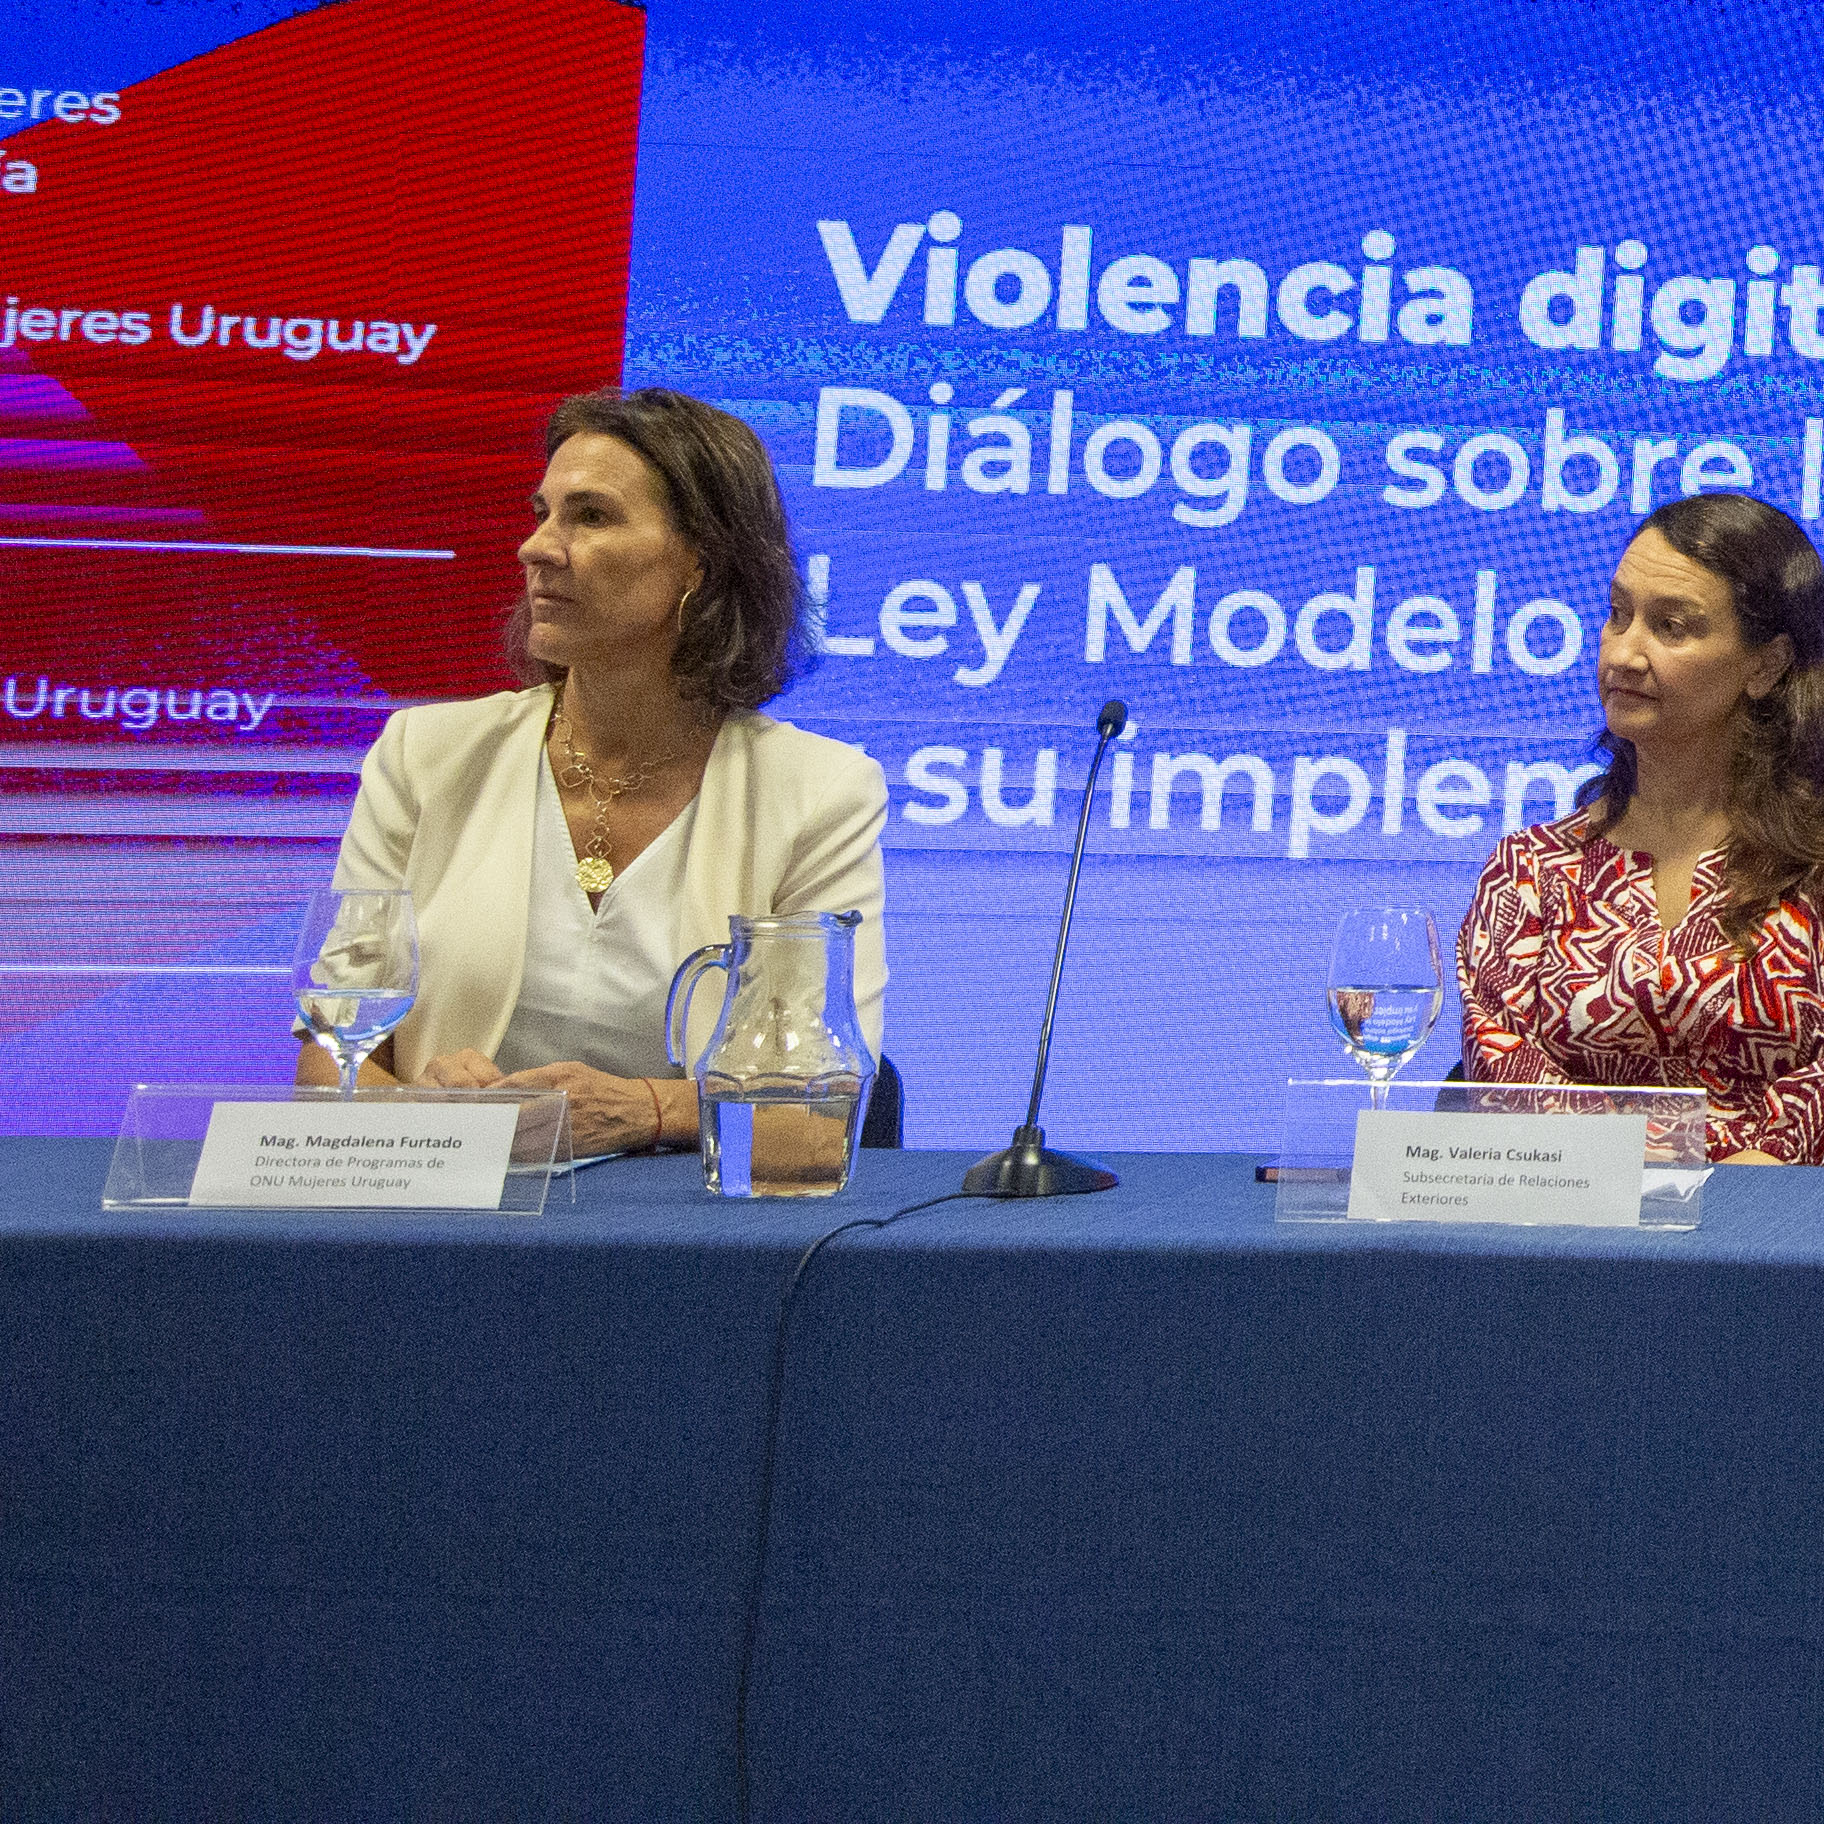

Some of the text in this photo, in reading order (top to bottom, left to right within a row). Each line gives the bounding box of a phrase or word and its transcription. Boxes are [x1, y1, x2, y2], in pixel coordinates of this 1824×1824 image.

[815, 210, 1474, 346] Violencia
[168, 303, 437, 365] Uruguay
[812, 381, 1341, 527] Diálogo
[1382, 407, 1755, 513] sobre
[803, 554, 1041, 688] Ley
[1083, 563, 1584, 677] Modelo
[2, 676, 278, 732] Uruguay
[902, 744, 1057, 827] su
[260, 1134, 463, 1152] Mag. Magdalena Furtado
[1405, 1145, 1562, 1163] Mag. Valeria Csukasi
[254, 1155, 445, 1172] Directora de Programas de
[1499, 1173, 1515, 1187] de
[1519, 1174, 1590, 1189] Relaciones
[249, 1175, 411, 1192] ONU Mujeres Uruguay
[1401, 1192, 1468, 1206] Exteriores
